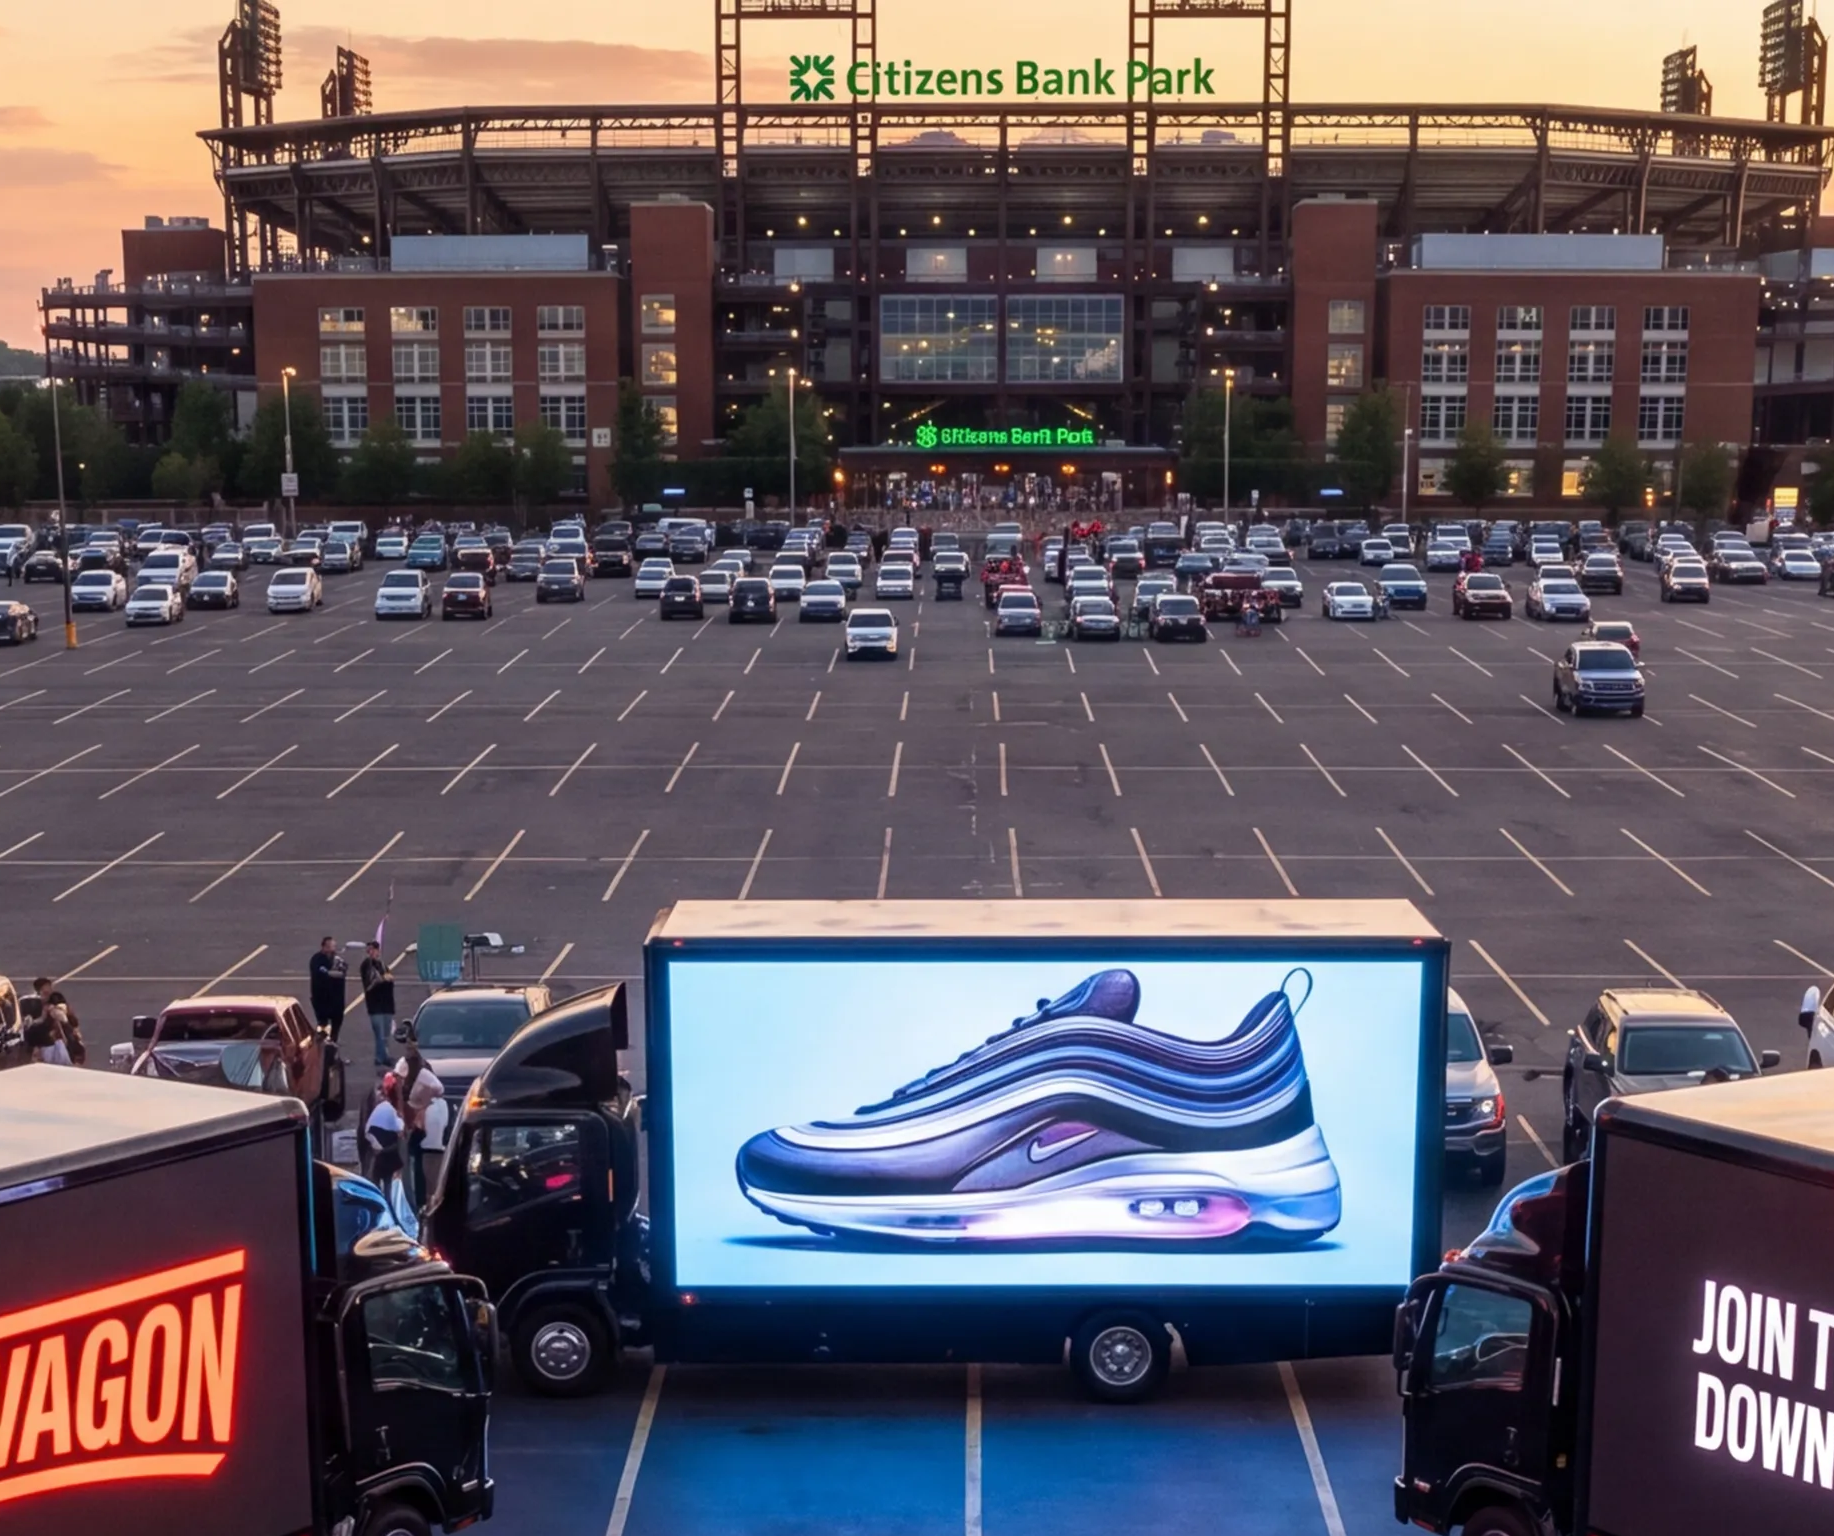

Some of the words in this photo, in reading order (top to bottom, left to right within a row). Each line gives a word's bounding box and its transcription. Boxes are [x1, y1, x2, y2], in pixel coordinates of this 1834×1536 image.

[847, 59, 1004, 96] Citizens
[1016, 58, 1115, 95] Bank
[1127, 58, 1214, 95] Park
[1692, 1279, 1797, 1381] JOIN
